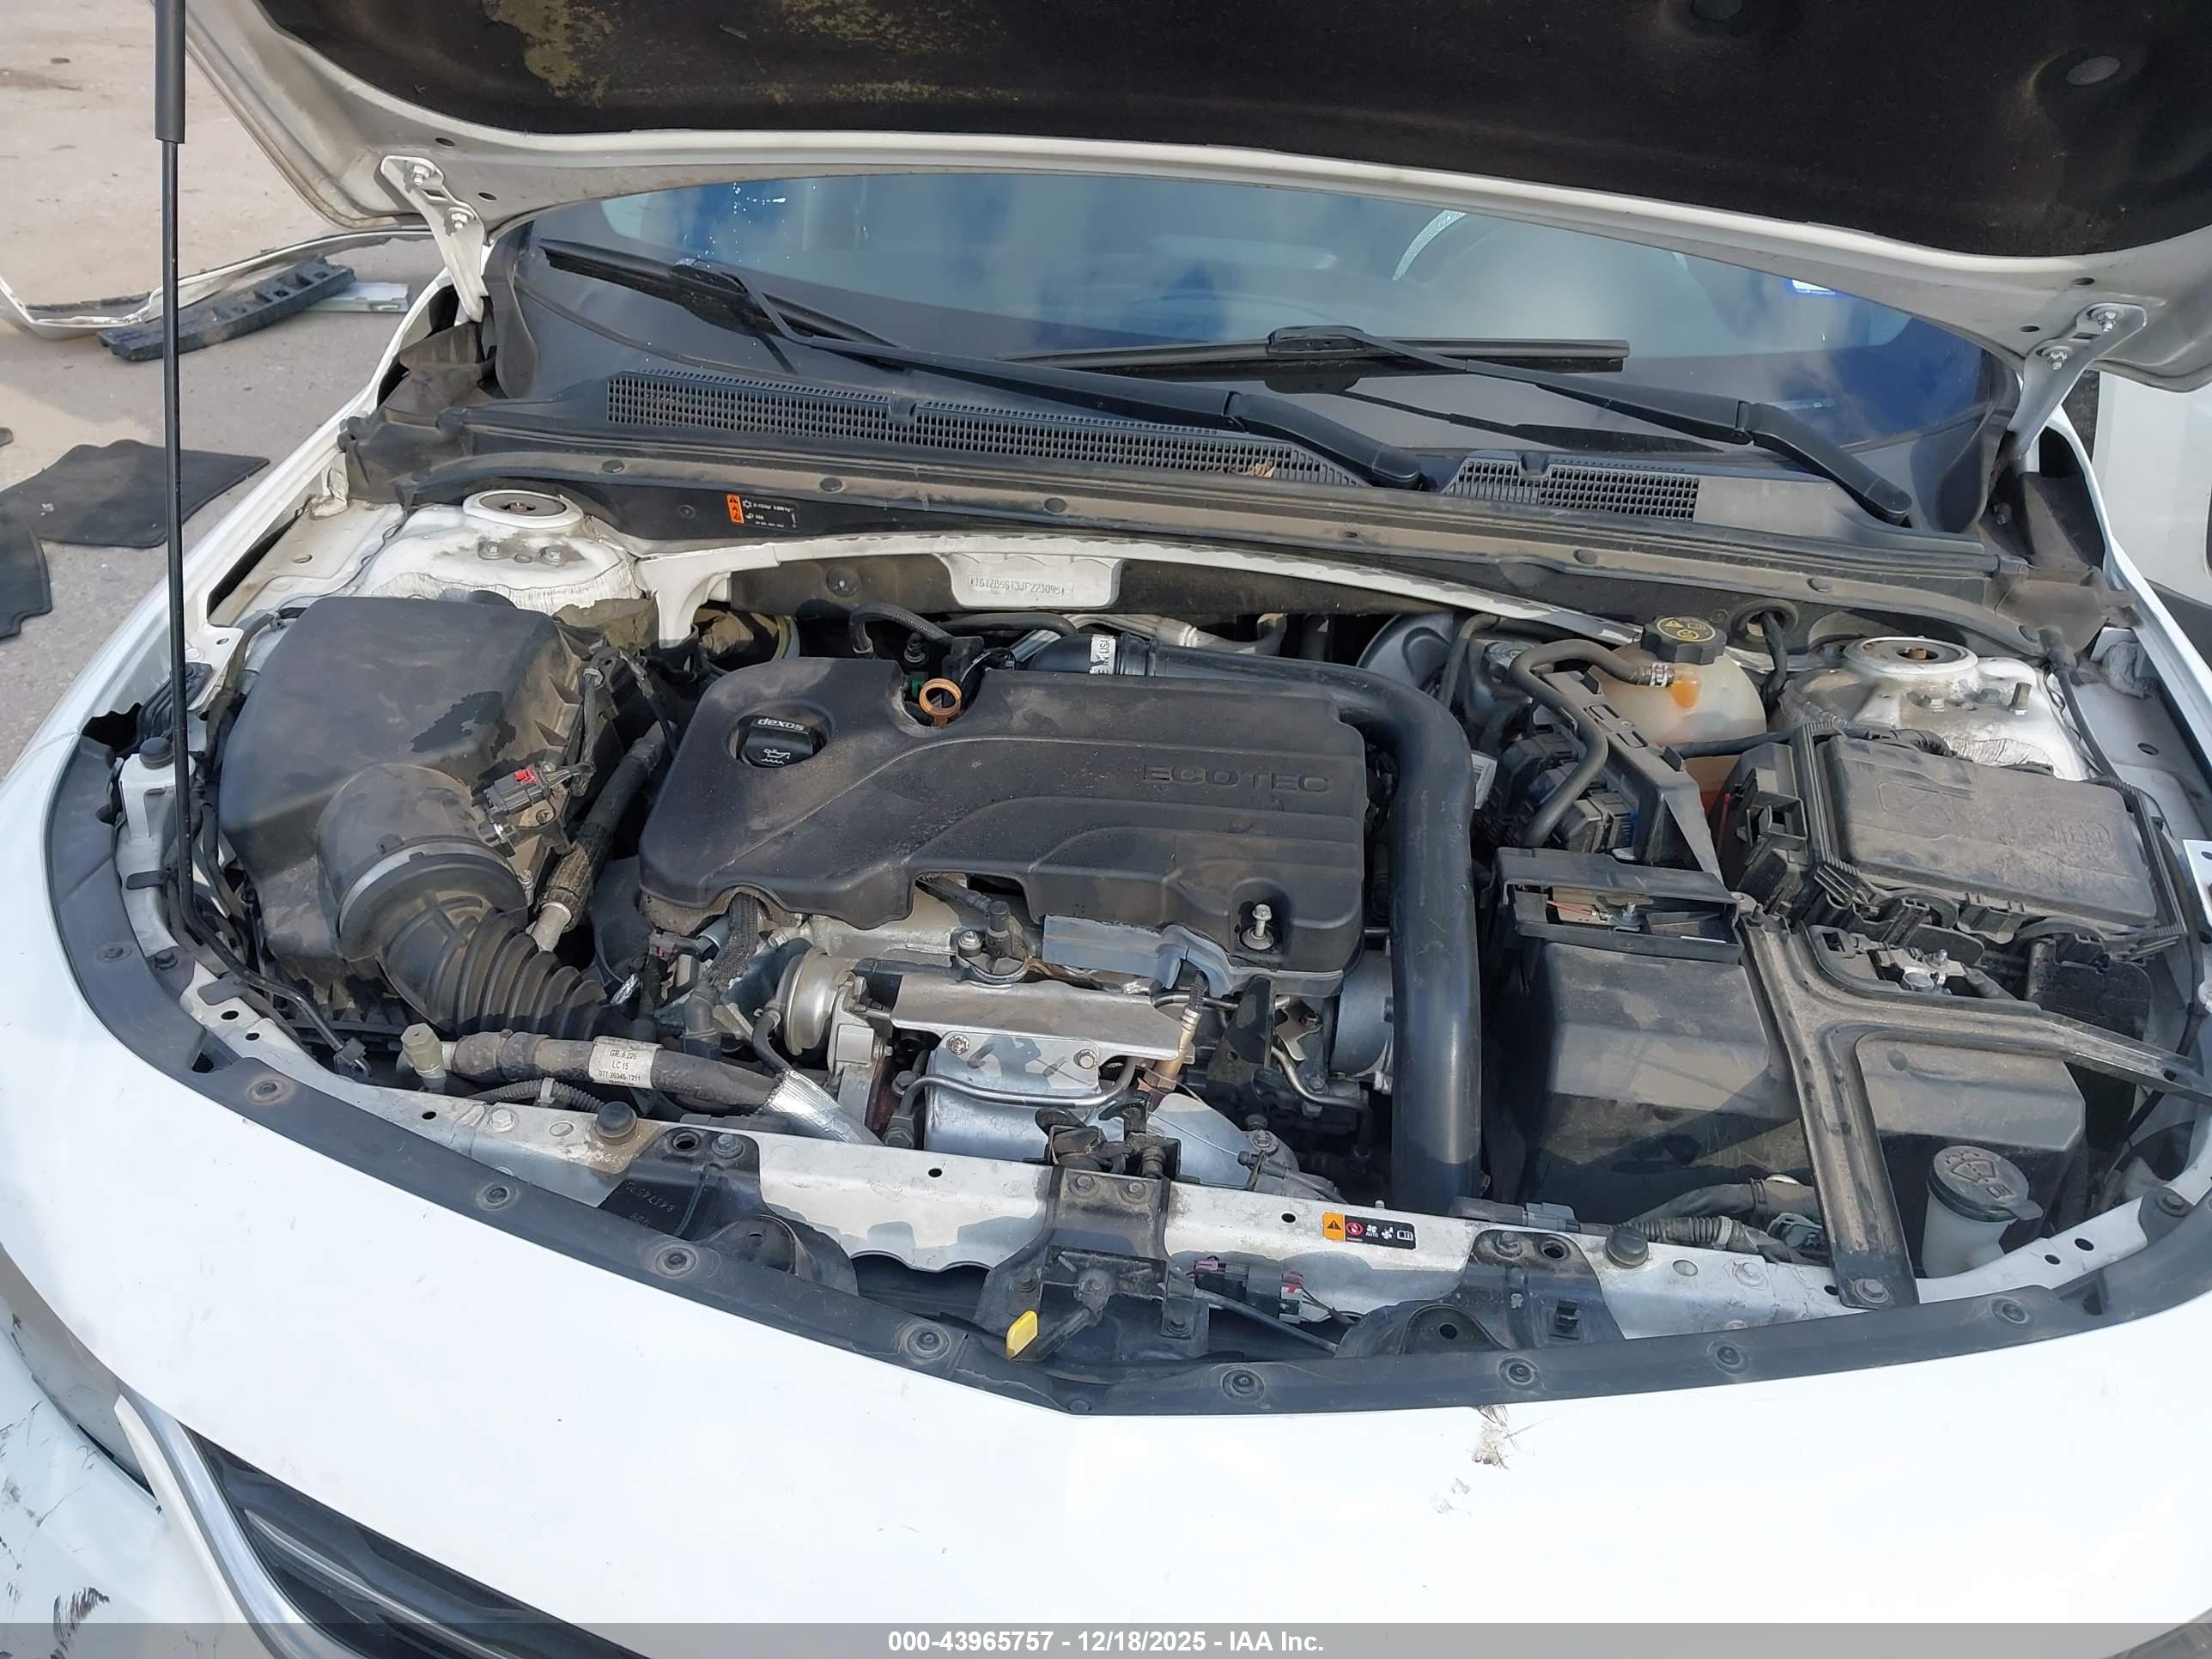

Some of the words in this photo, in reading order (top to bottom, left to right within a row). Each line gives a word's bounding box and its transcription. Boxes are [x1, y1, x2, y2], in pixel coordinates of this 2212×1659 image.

[1099, 640, 1110, 654] USA
[757, 718, 805, 731] dexos
[1144, 763, 1330, 793] ECOTEC
[611, 1060, 621, 1069] LC
